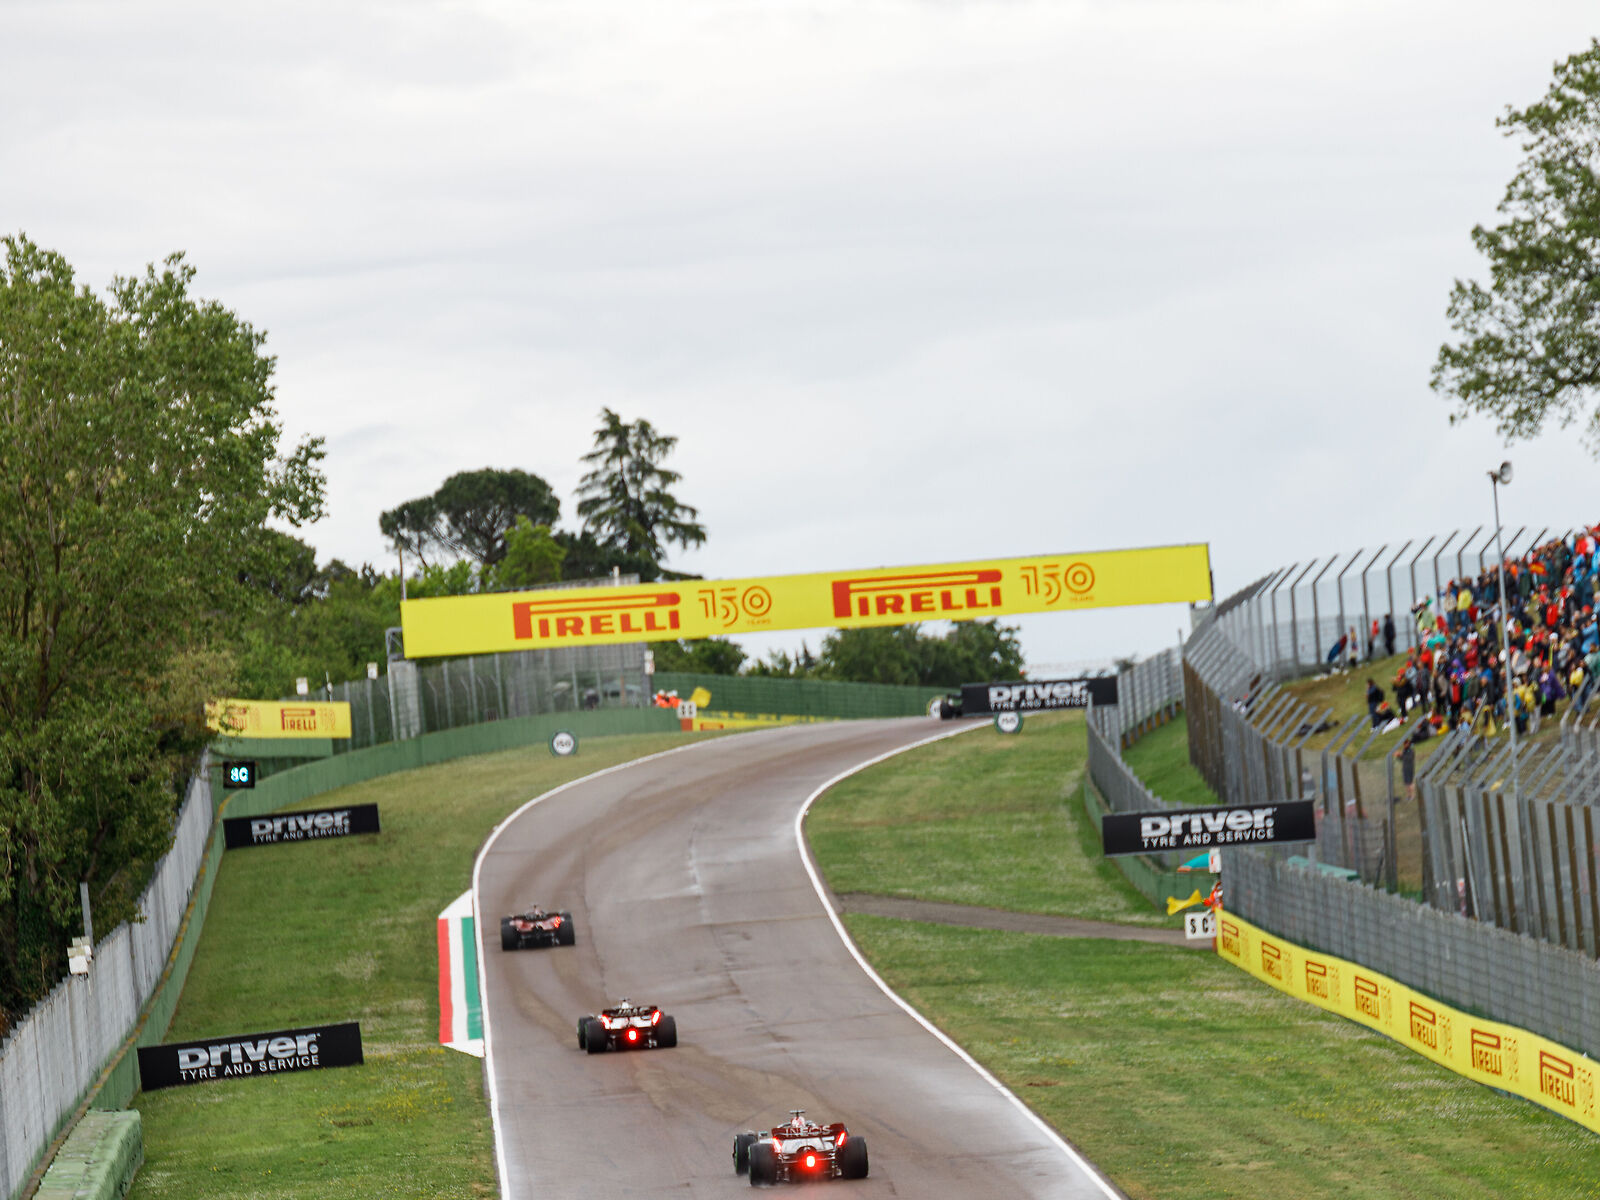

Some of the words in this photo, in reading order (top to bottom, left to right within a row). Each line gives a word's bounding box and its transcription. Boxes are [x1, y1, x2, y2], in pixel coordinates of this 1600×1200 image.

[512, 592, 681, 640] PIRELLI
[698, 585, 772, 628] 150
[831, 569, 1003, 618] PIRELLI
[1020, 562, 1095, 606] 150
[280, 708, 317, 731] PIRELLI
[253, 834, 278, 843] TYRE
[283, 830, 303, 840] AND
[307, 825, 350, 838] SERVICE
[1142, 836, 1177, 848] TYRE
[1183, 832, 1211, 846] AND
[1217, 828, 1275, 843] SERVICE
[1409, 1000, 1437, 1050] PIRELLI
[180, 1066, 217, 1081] TYRE
[224, 1062, 253, 1077] AND
[259, 1054, 320, 1072] SERVICE
[1471, 1028, 1502, 1076] PIRELLI
[1539, 1049, 1575, 1107] PIRELLI
